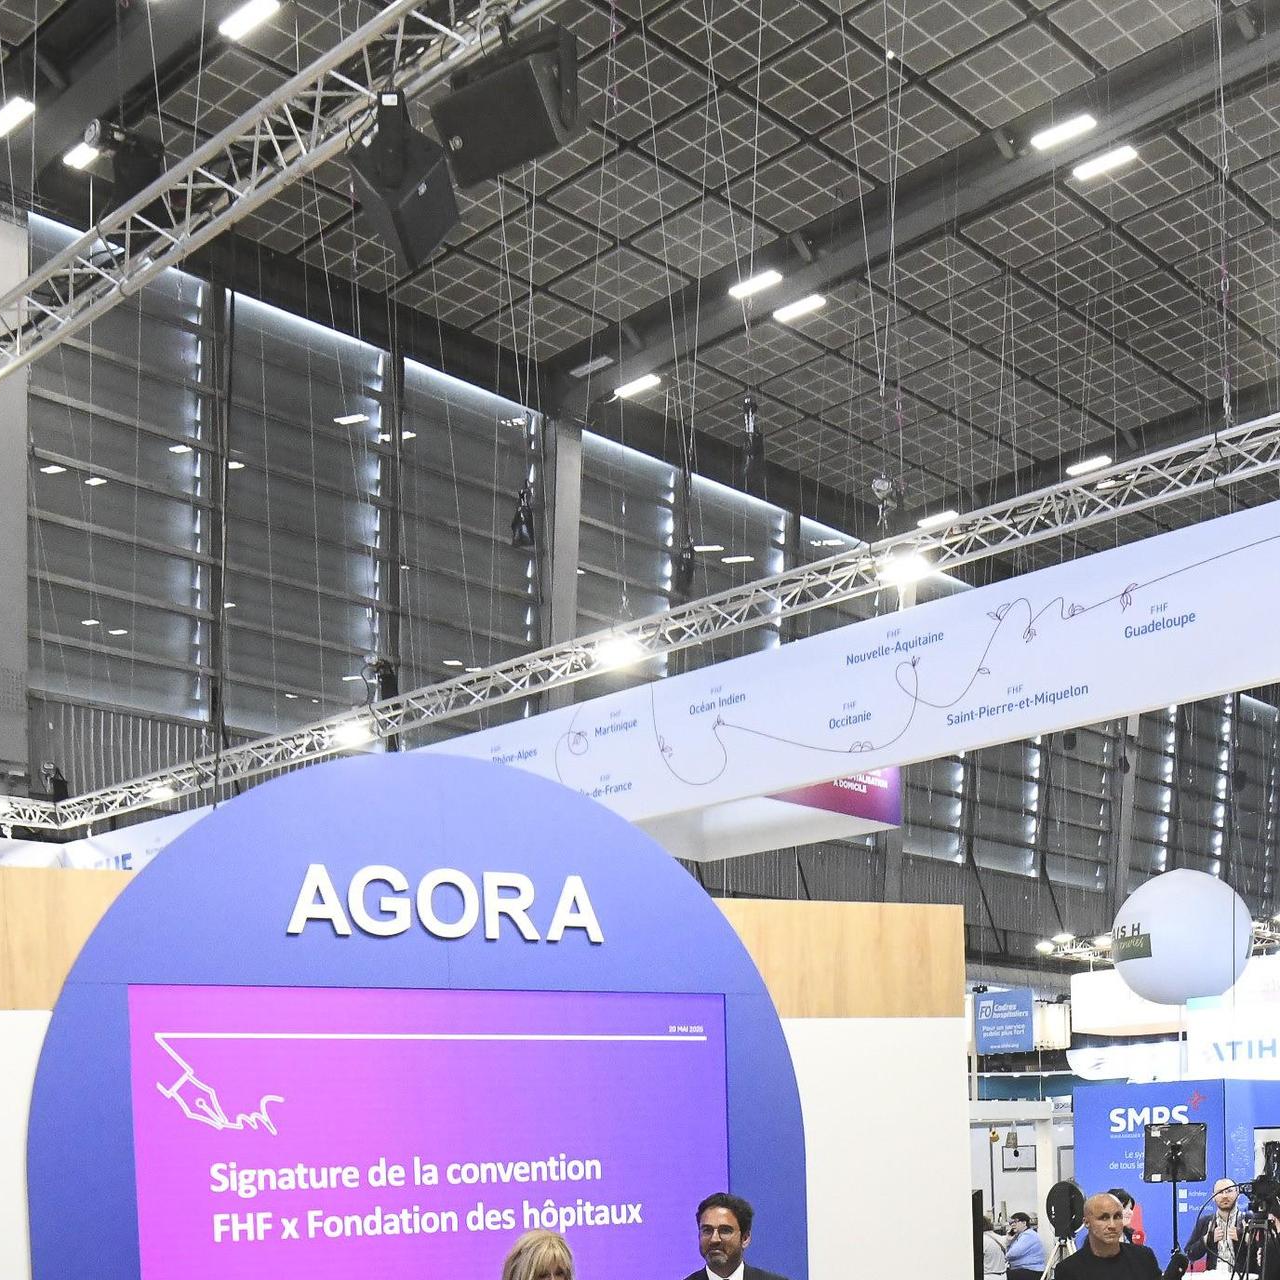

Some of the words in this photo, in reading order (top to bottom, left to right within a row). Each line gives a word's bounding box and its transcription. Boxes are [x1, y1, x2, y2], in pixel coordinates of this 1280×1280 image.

[1149, 602, 1169, 616] FHF
[886, 628, 902, 639] FHF
[1123, 610, 1197, 640] Guadeloupe
[846, 630, 945, 667] Nouvelle-Aquitaine
[1007, 684, 1024, 696] FHF
[689, 699, 716, 716] Océan
[718, 691, 747, 709] Indien
[842, 699, 858, 711] FHF
[946, 682, 1090, 727] Saint-Pierre-et-Miquelon
[594, 718, 639, 738] Martinique
[828, 709, 873, 730] Occitanie
[286, 864, 605, 944] AGORA
[1131, 922, 1141, 936] H
[980, 1005, 992, 1018] FO
[992, 1010, 1029, 1019] hospitaliers
[993, 1003, 1017, 1012] Cadres
[1108, 1104, 1189, 1133] SMPS
[1109, 1161, 1119, 1170] de
[1120, 1161, 1136, 1170] tous
[209, 1159, 360, 1199] Signature
[367, 1157, 407, 1187] de
[413, 1156, 439, 1187] la
[446, 1153, 603, 1185] convention
[213, 1212, 273, 1243] FHF
[280, 1216, 300, 1241] x
[308, 1206, 458, 1239] Fondation
[466, 1202, 516, 1232] des
[522, 1199, 644, 1233] hôpitaux
